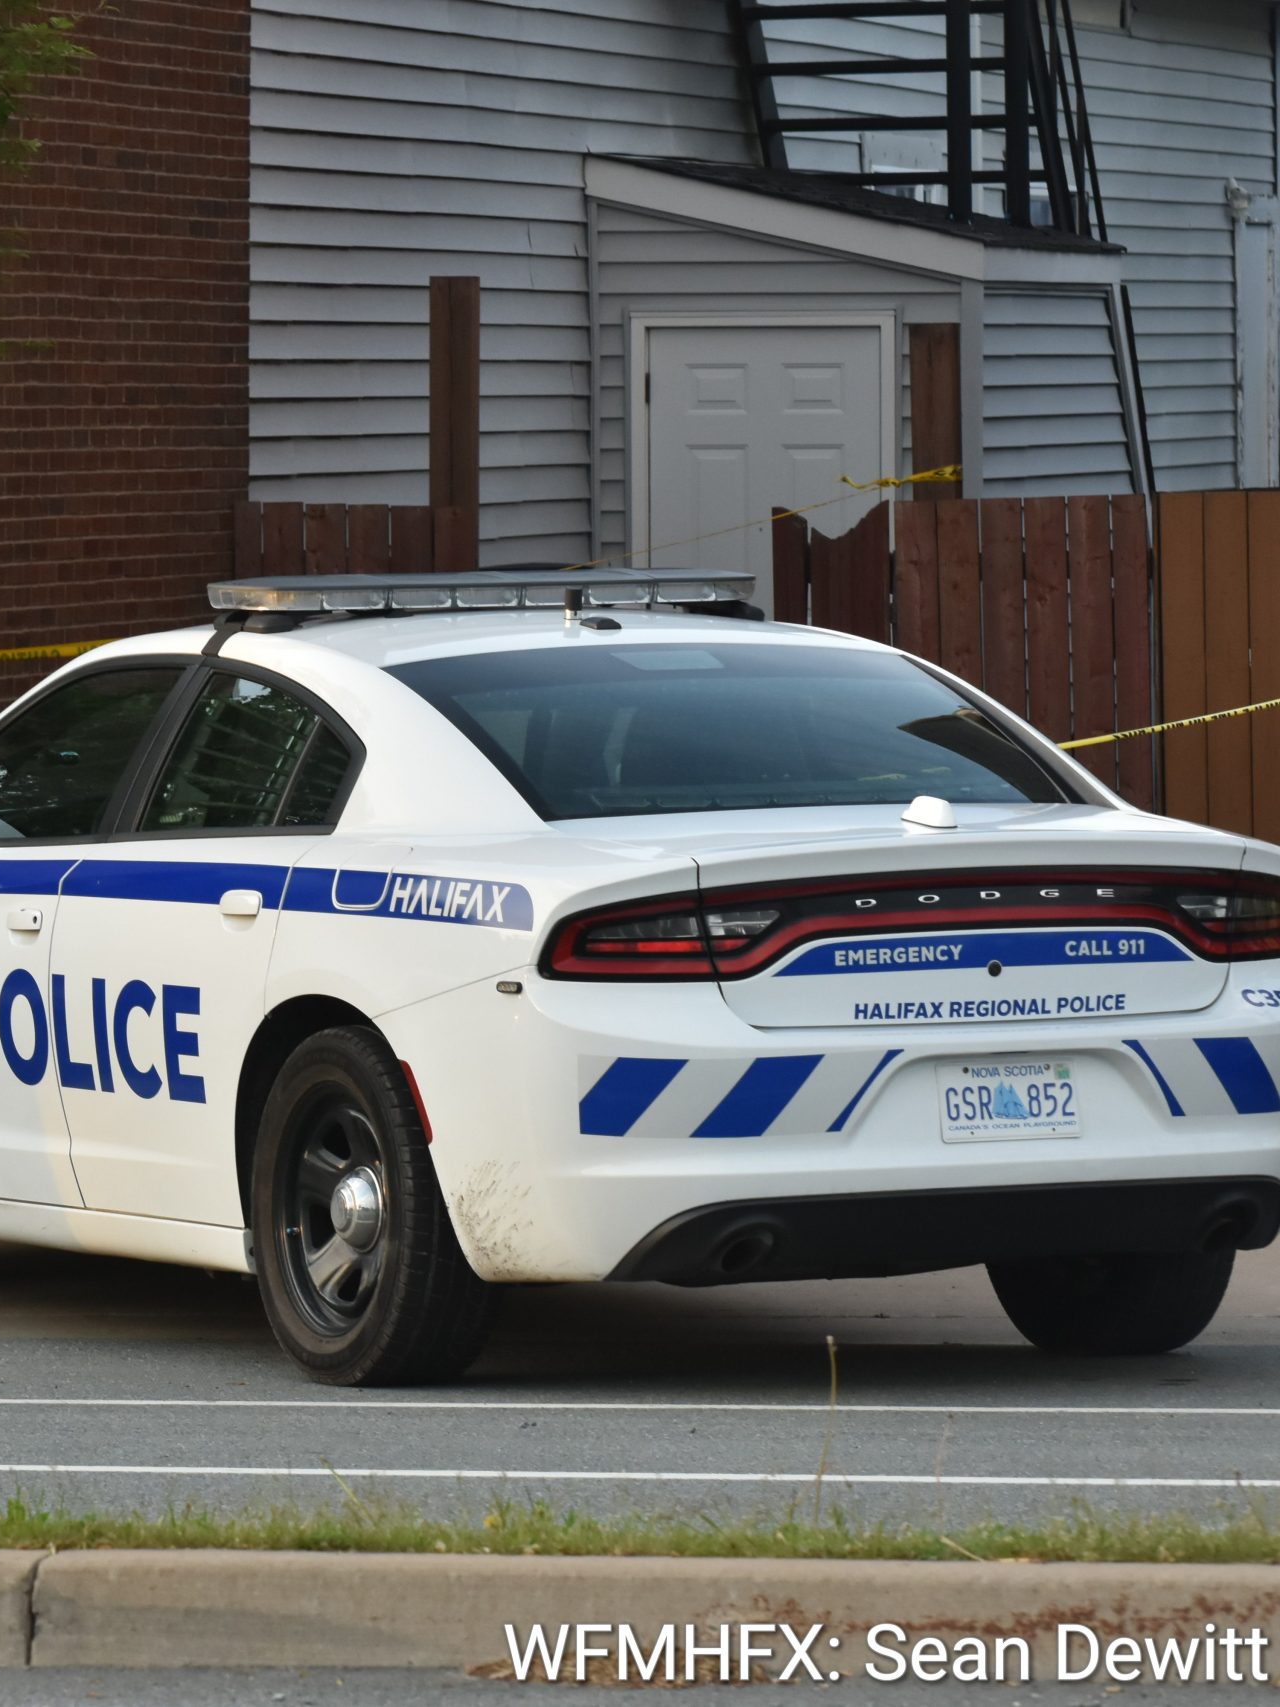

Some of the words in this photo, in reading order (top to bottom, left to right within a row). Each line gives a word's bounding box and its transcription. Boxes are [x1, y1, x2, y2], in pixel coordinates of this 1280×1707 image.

[389, 876, 512, 923] HALIFAX
[855, 888, 1116, 908] DODGE
[834, 943, 963, 967] EMERGENCY
[1064, 939, 1113, 957] CALL
[1118, 938, 1146, 956] 911
[854, 1001, 945, 1020] HALIFAX
[949, 998, 1052, 1018] REGIONAL
[1056, 994, 1126, 1014] POLICE
[971, 1067, 1001, 1079] NOVA
[1004, 1064, 1044, 1077] SCOTIA
[945, 1085, 994, 1121] GSR
[1027, 1082, 1076, 1118] 852
[948, 1123, 989, 1132] CANADA'S
[992, 1122, 1020, 1130] OCEAN
[1023, 1120, 1078, 1129] PLAYGROUND
